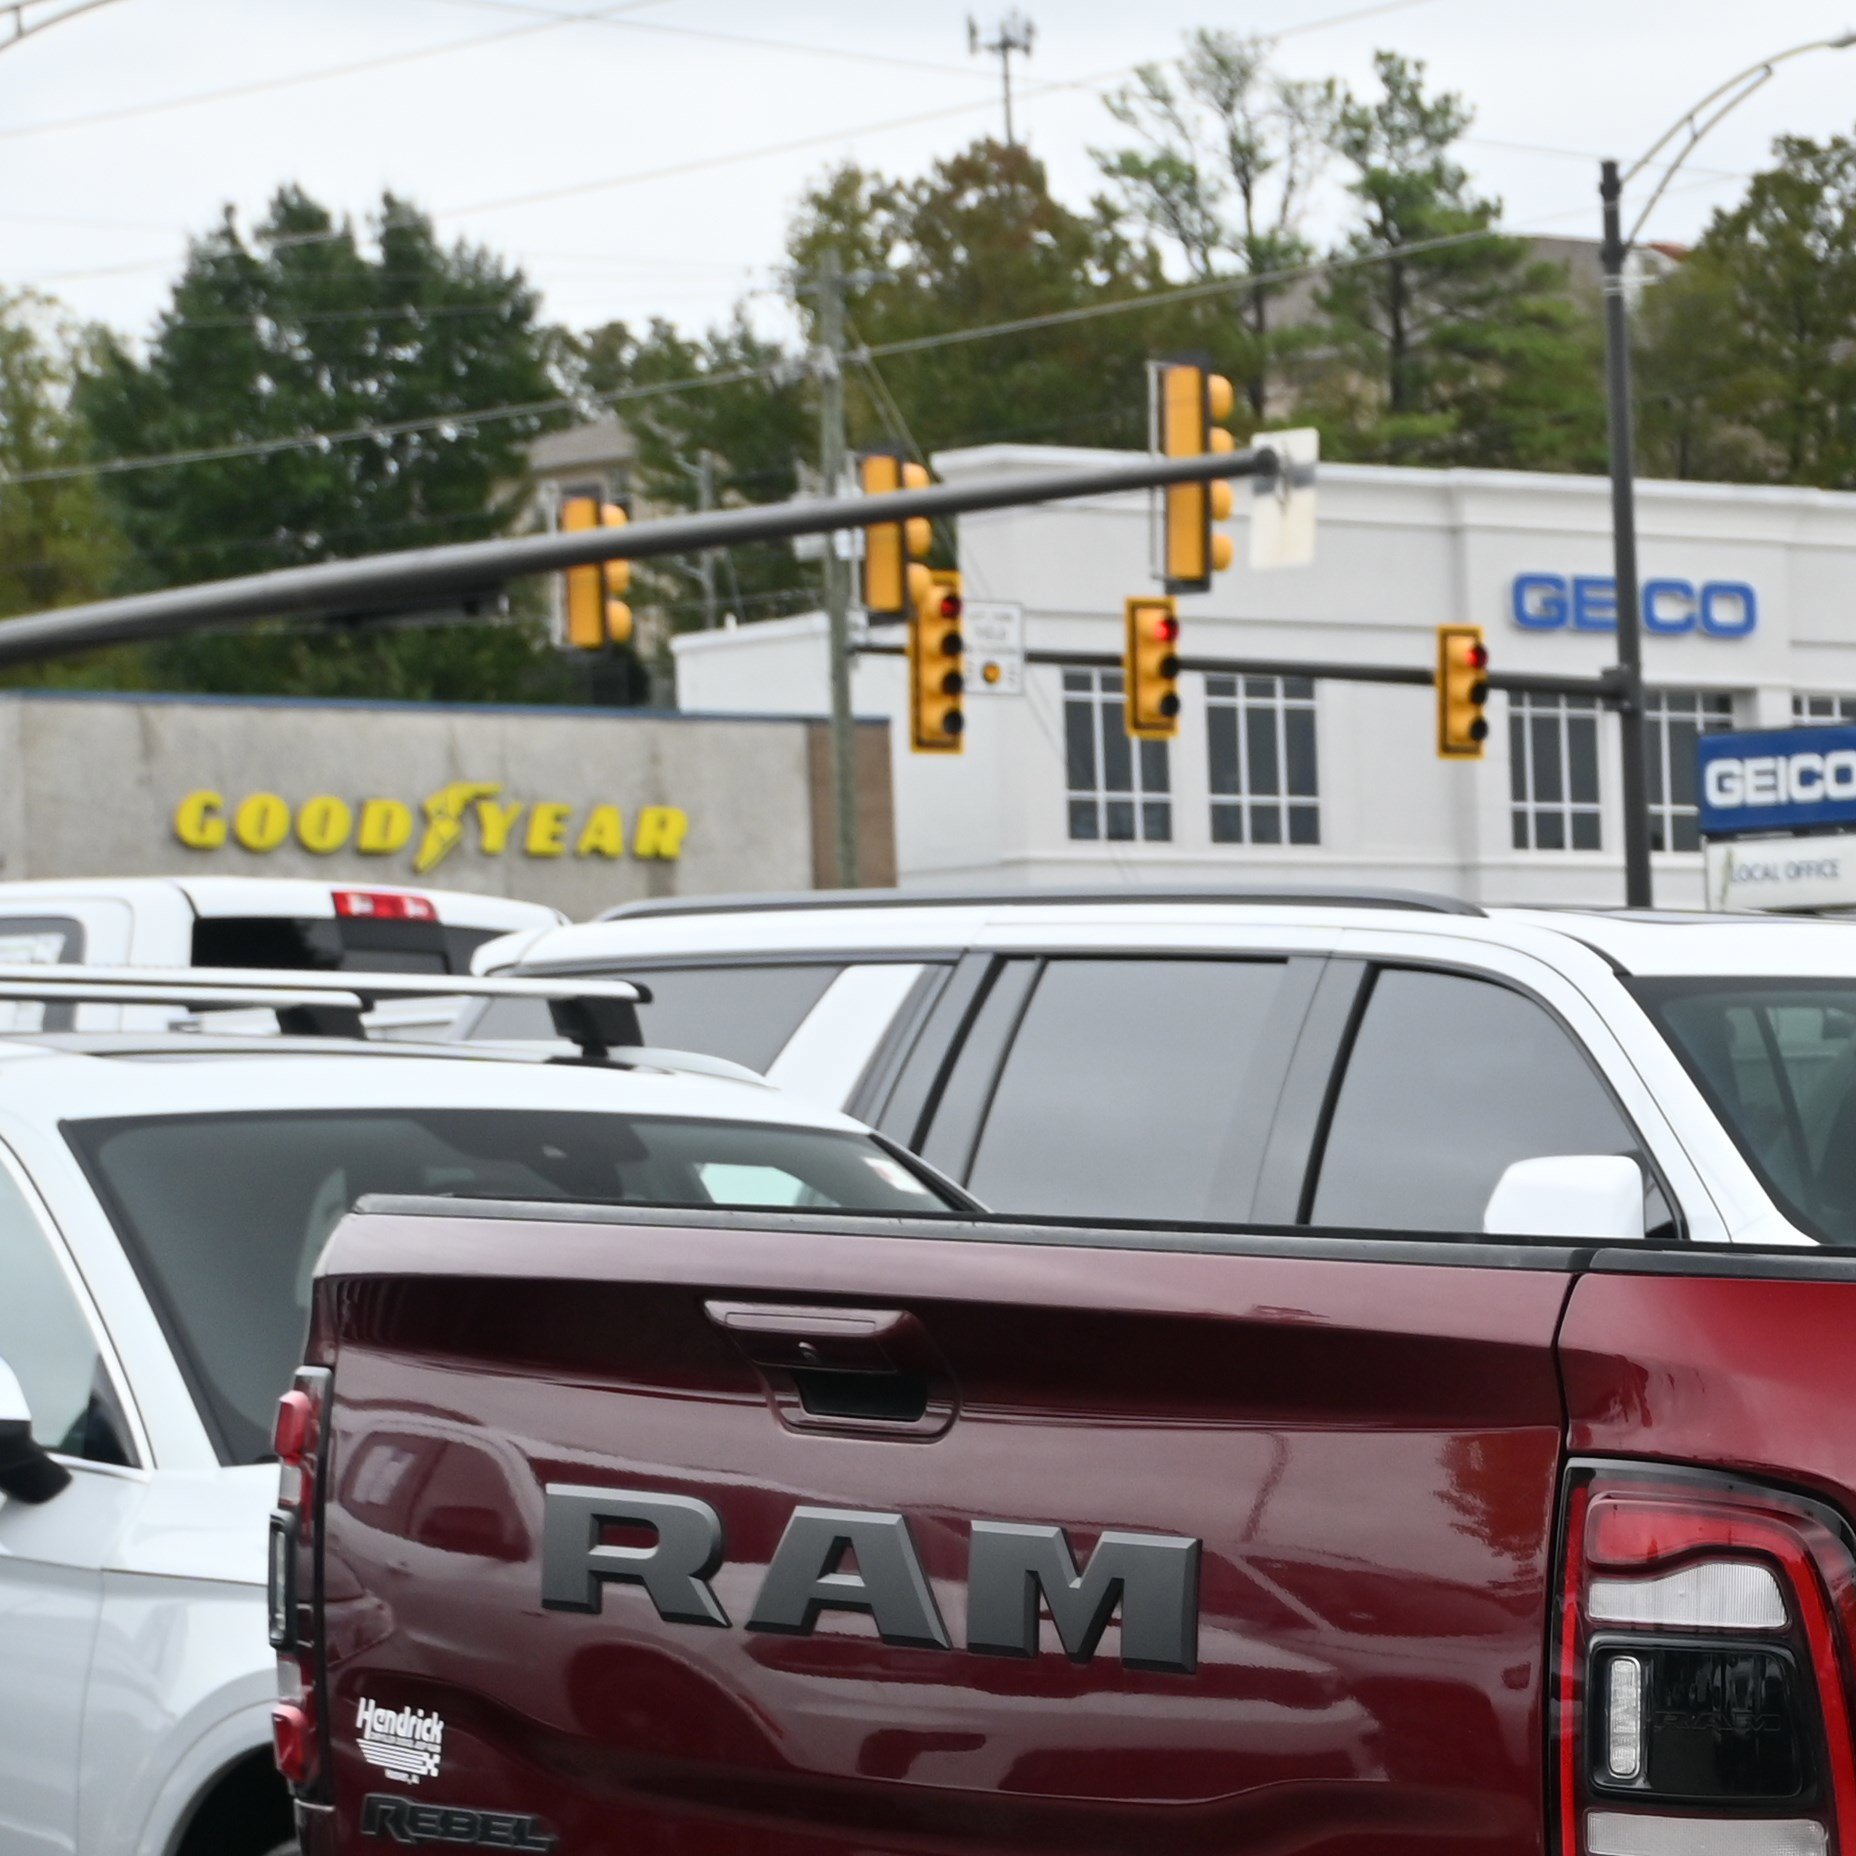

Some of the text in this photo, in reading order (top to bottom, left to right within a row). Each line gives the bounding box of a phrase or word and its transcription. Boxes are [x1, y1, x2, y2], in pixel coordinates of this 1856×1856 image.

[1511, 572, 1758, 638] GECO
[172, 784, 690, 868] GOODYEAR
[1786, 858, 1840, 880] OFFICE
[540, 1483, 1203, 1675] RAM
[355, 1696, 444, 1745] Hendrick
[361, 1793, 559, 1851] REBEL
